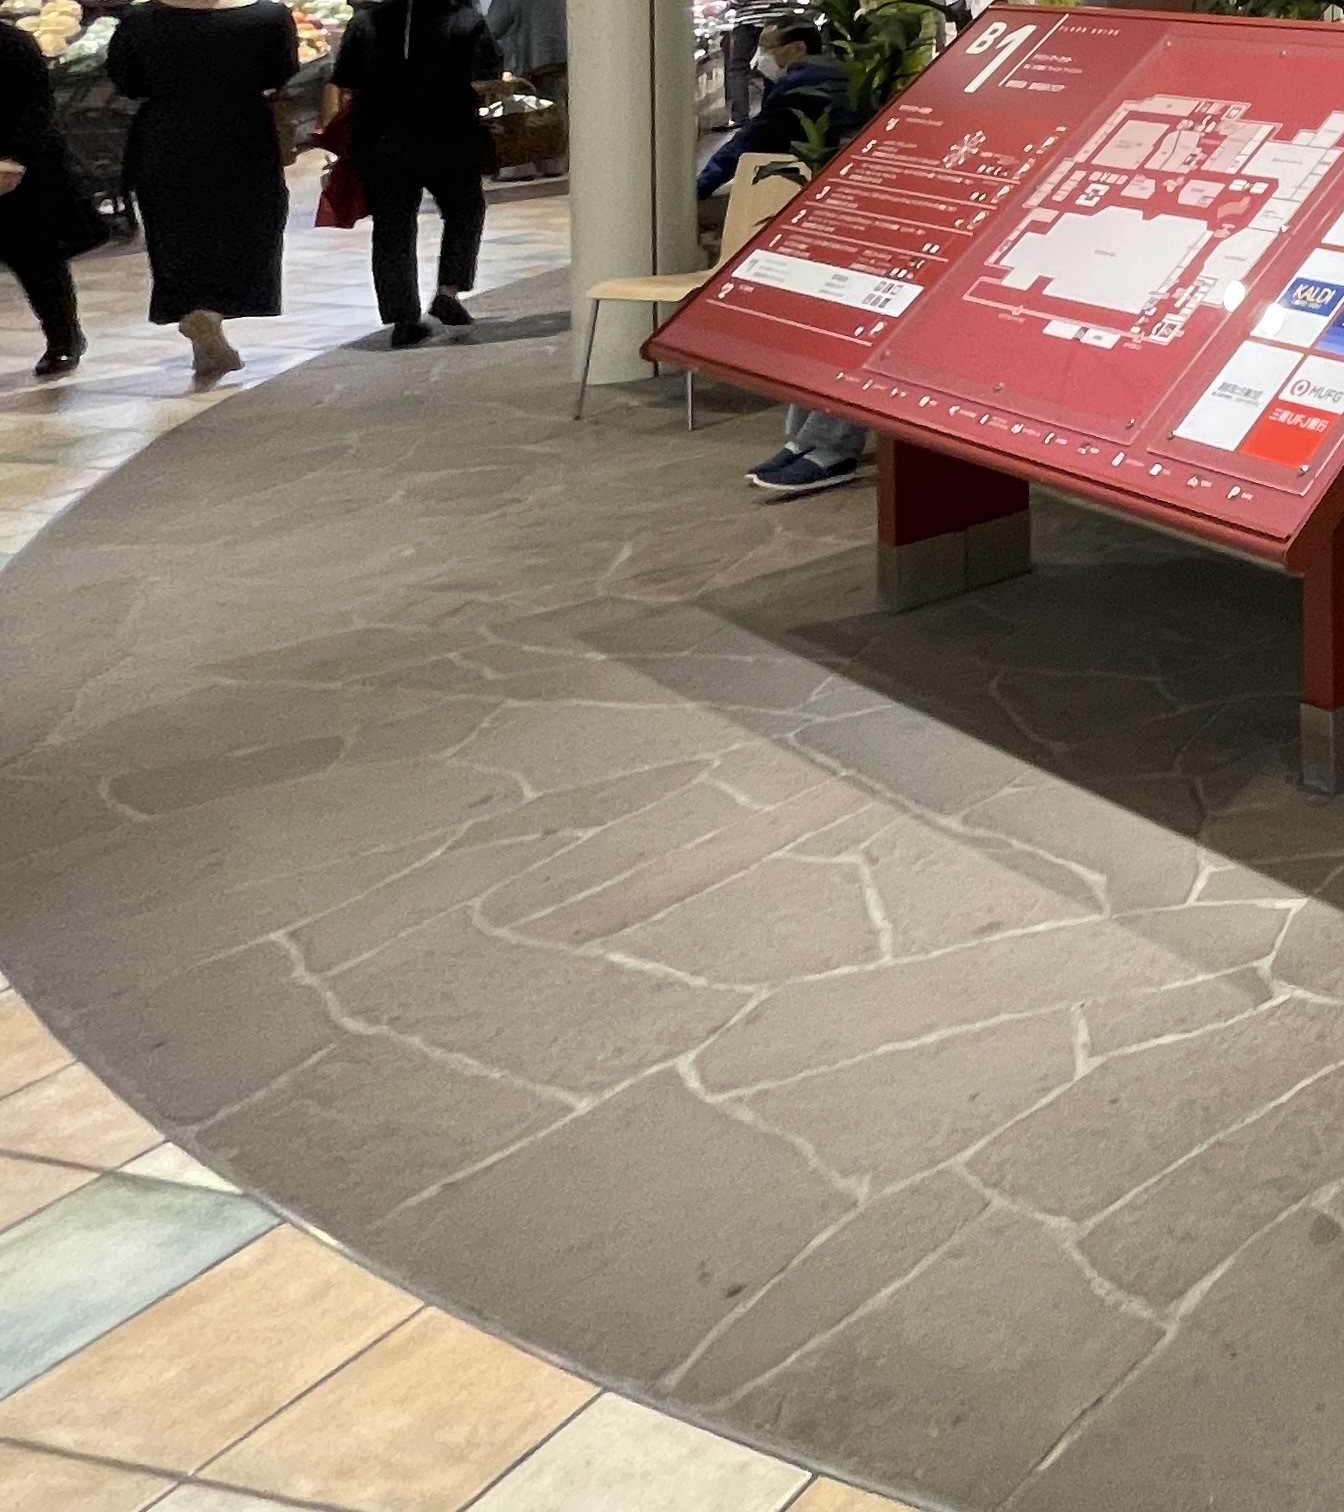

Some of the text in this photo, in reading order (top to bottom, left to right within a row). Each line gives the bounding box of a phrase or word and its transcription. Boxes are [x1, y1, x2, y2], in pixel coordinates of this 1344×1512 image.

[963, 20, 1038, 94] B1
[1291, 283, 1337, 306] KALDI
[1309, 385, 1344, 404] MUFG
